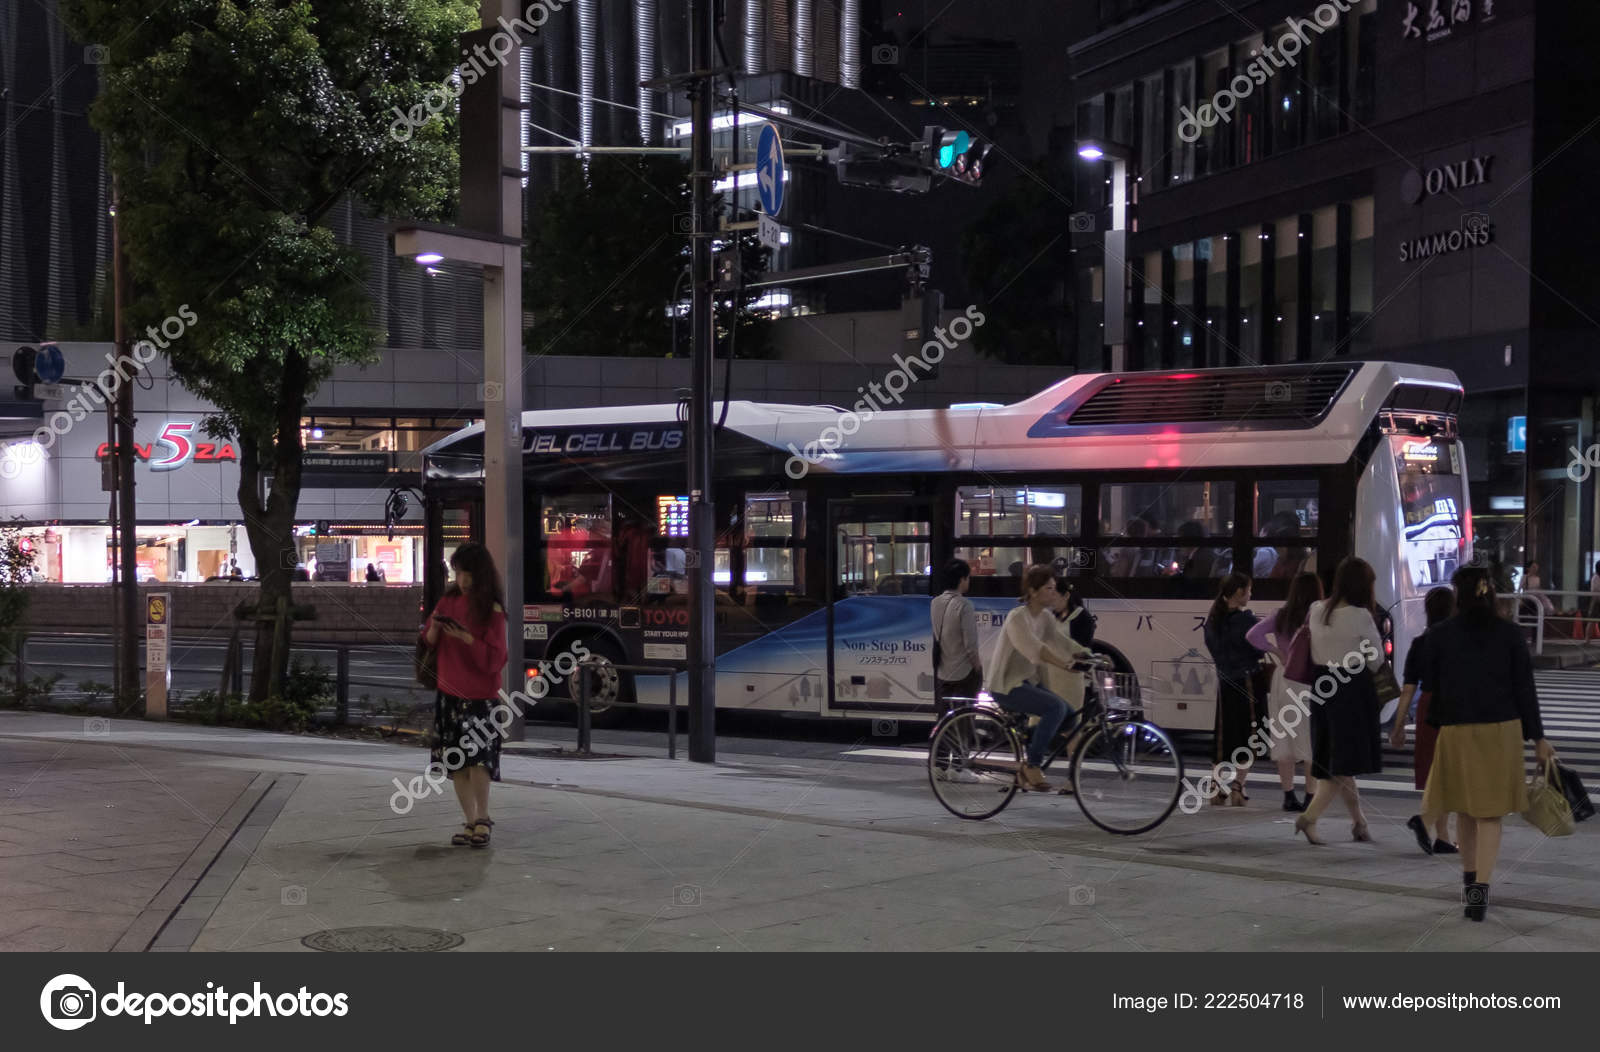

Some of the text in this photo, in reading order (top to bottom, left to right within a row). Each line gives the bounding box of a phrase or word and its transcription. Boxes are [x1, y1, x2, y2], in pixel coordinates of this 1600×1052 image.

[1425, 155, 1490, 195] ONLY
[1399, 224, 1490, 262] SIMMONS
[521, 430, 684, 454] UEL CELL BUS
[643, 609, 689, 624] TOYO
[903, 639, 927, 652] Bus
